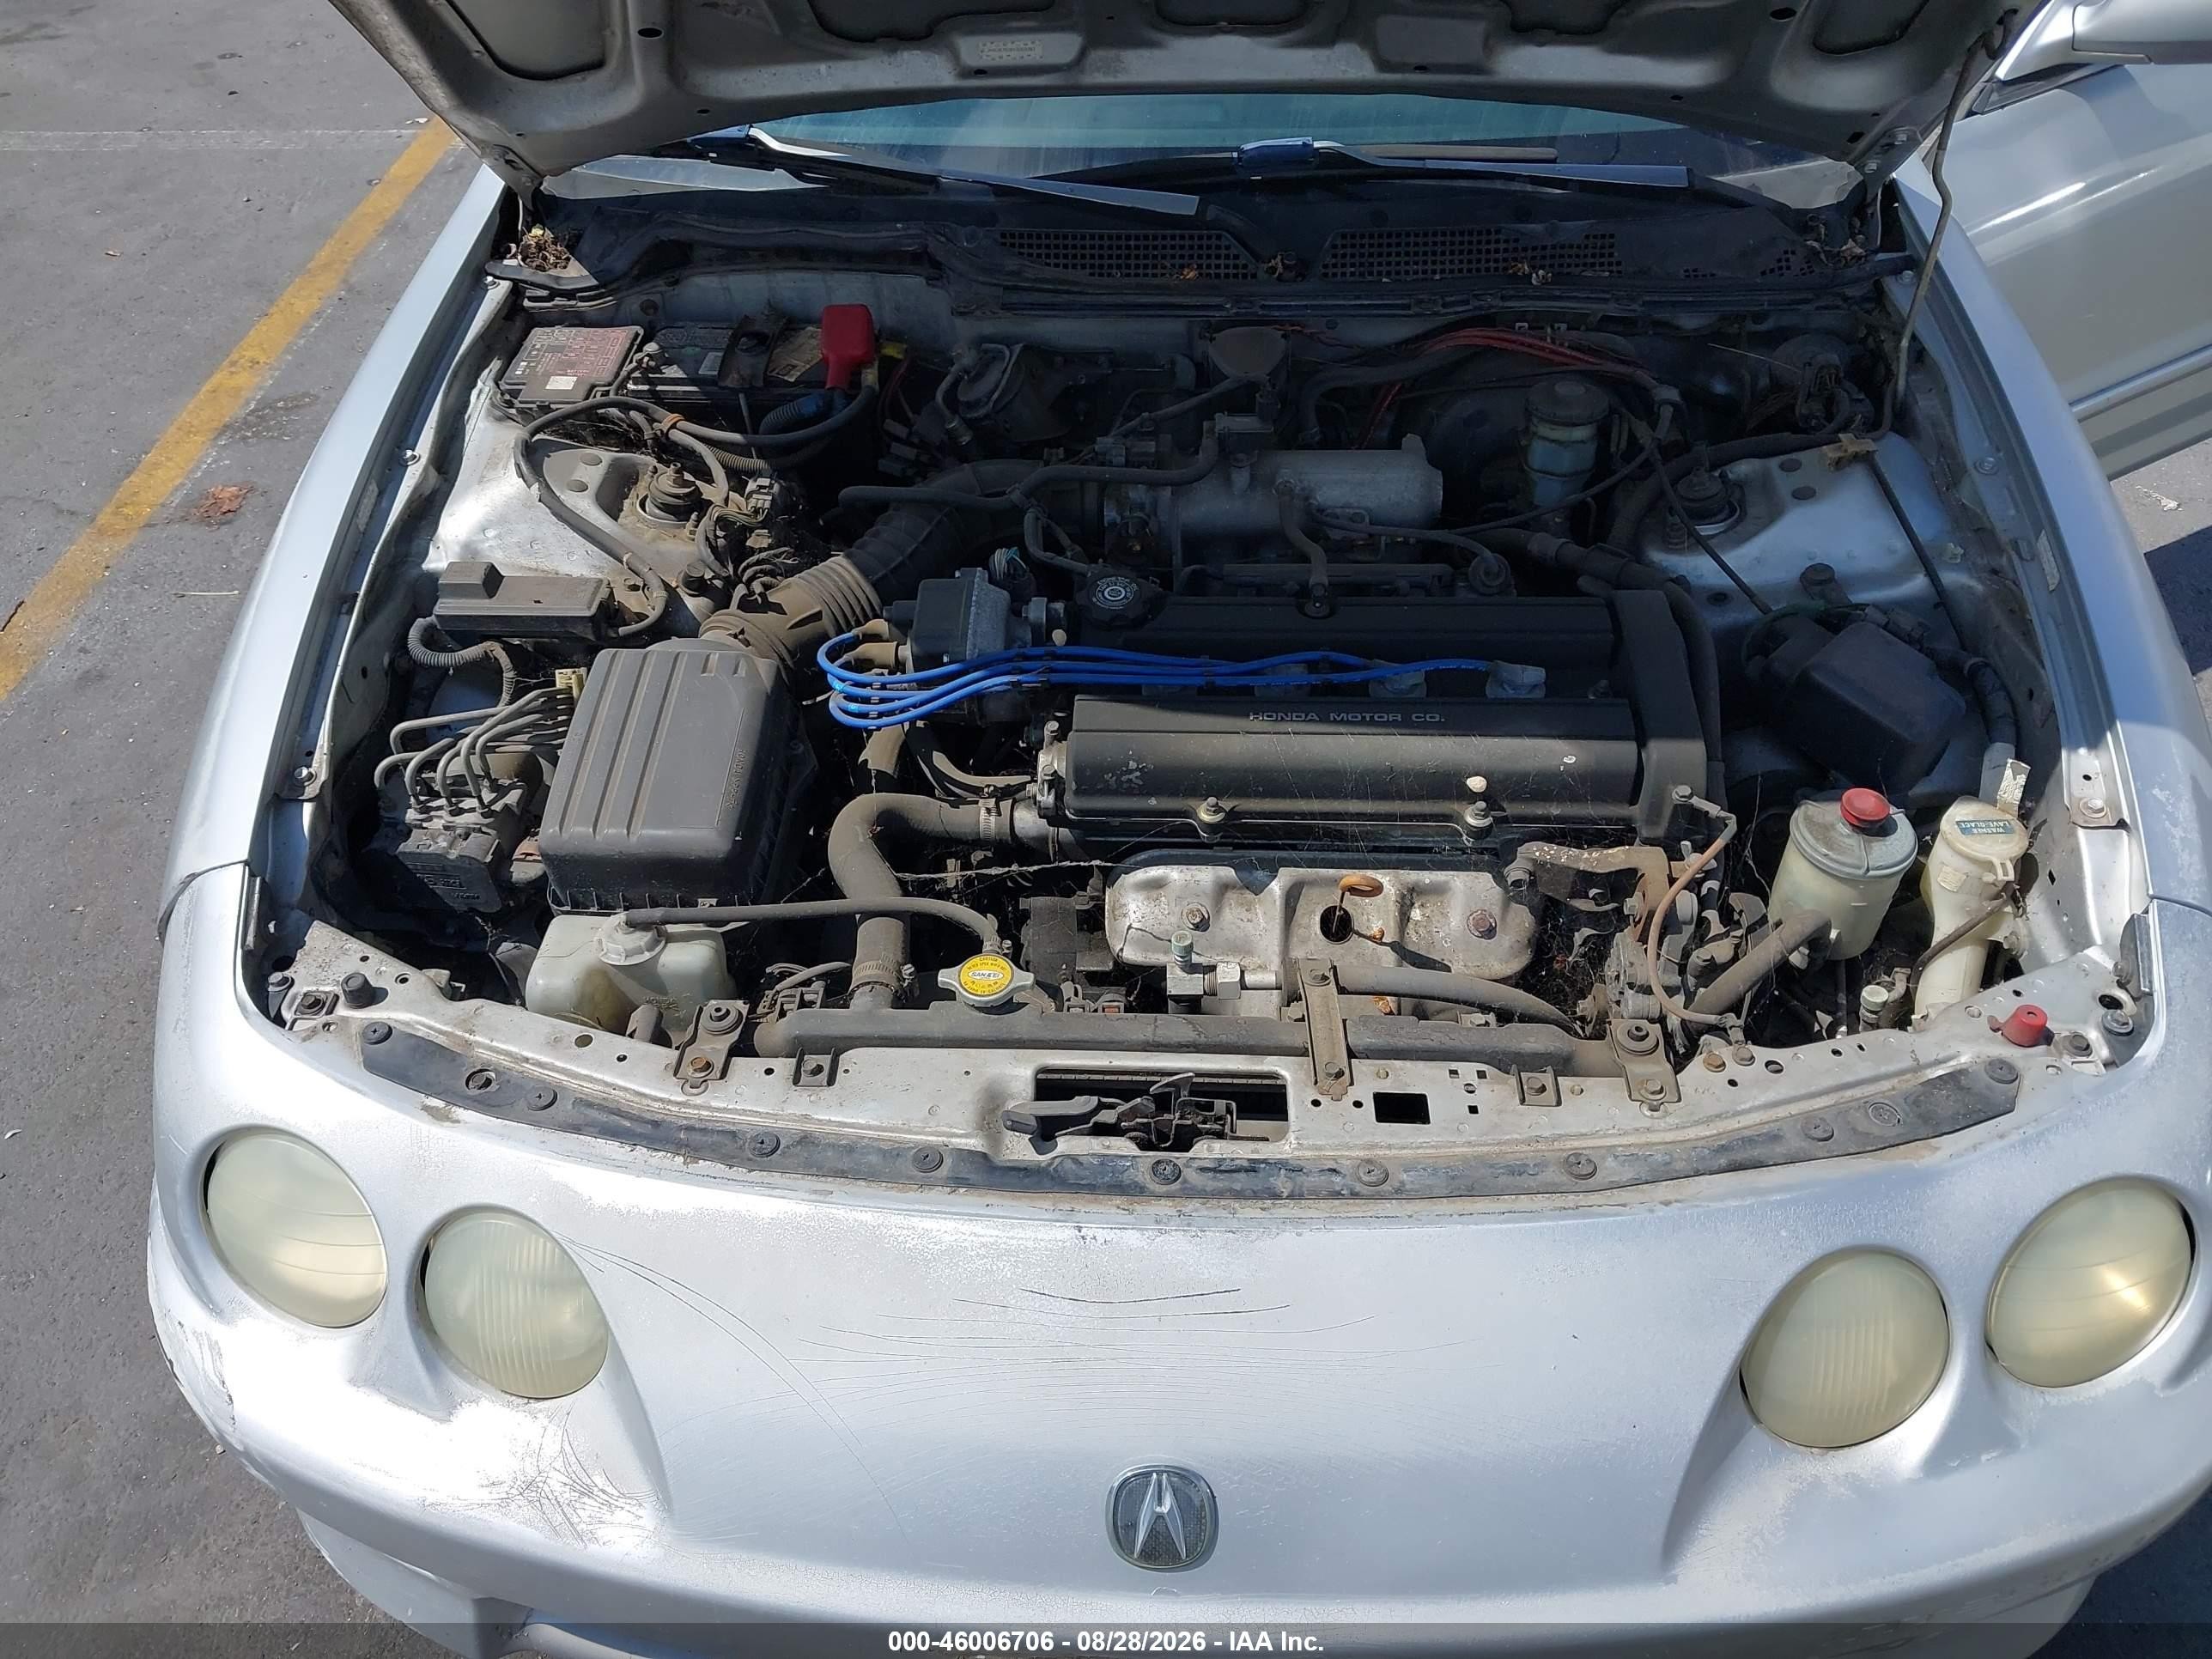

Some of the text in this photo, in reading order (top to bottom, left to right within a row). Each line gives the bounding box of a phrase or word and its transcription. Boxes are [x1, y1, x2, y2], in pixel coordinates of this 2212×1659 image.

[1249, 712, 1445, 722] HONDA MOTOR CO.
